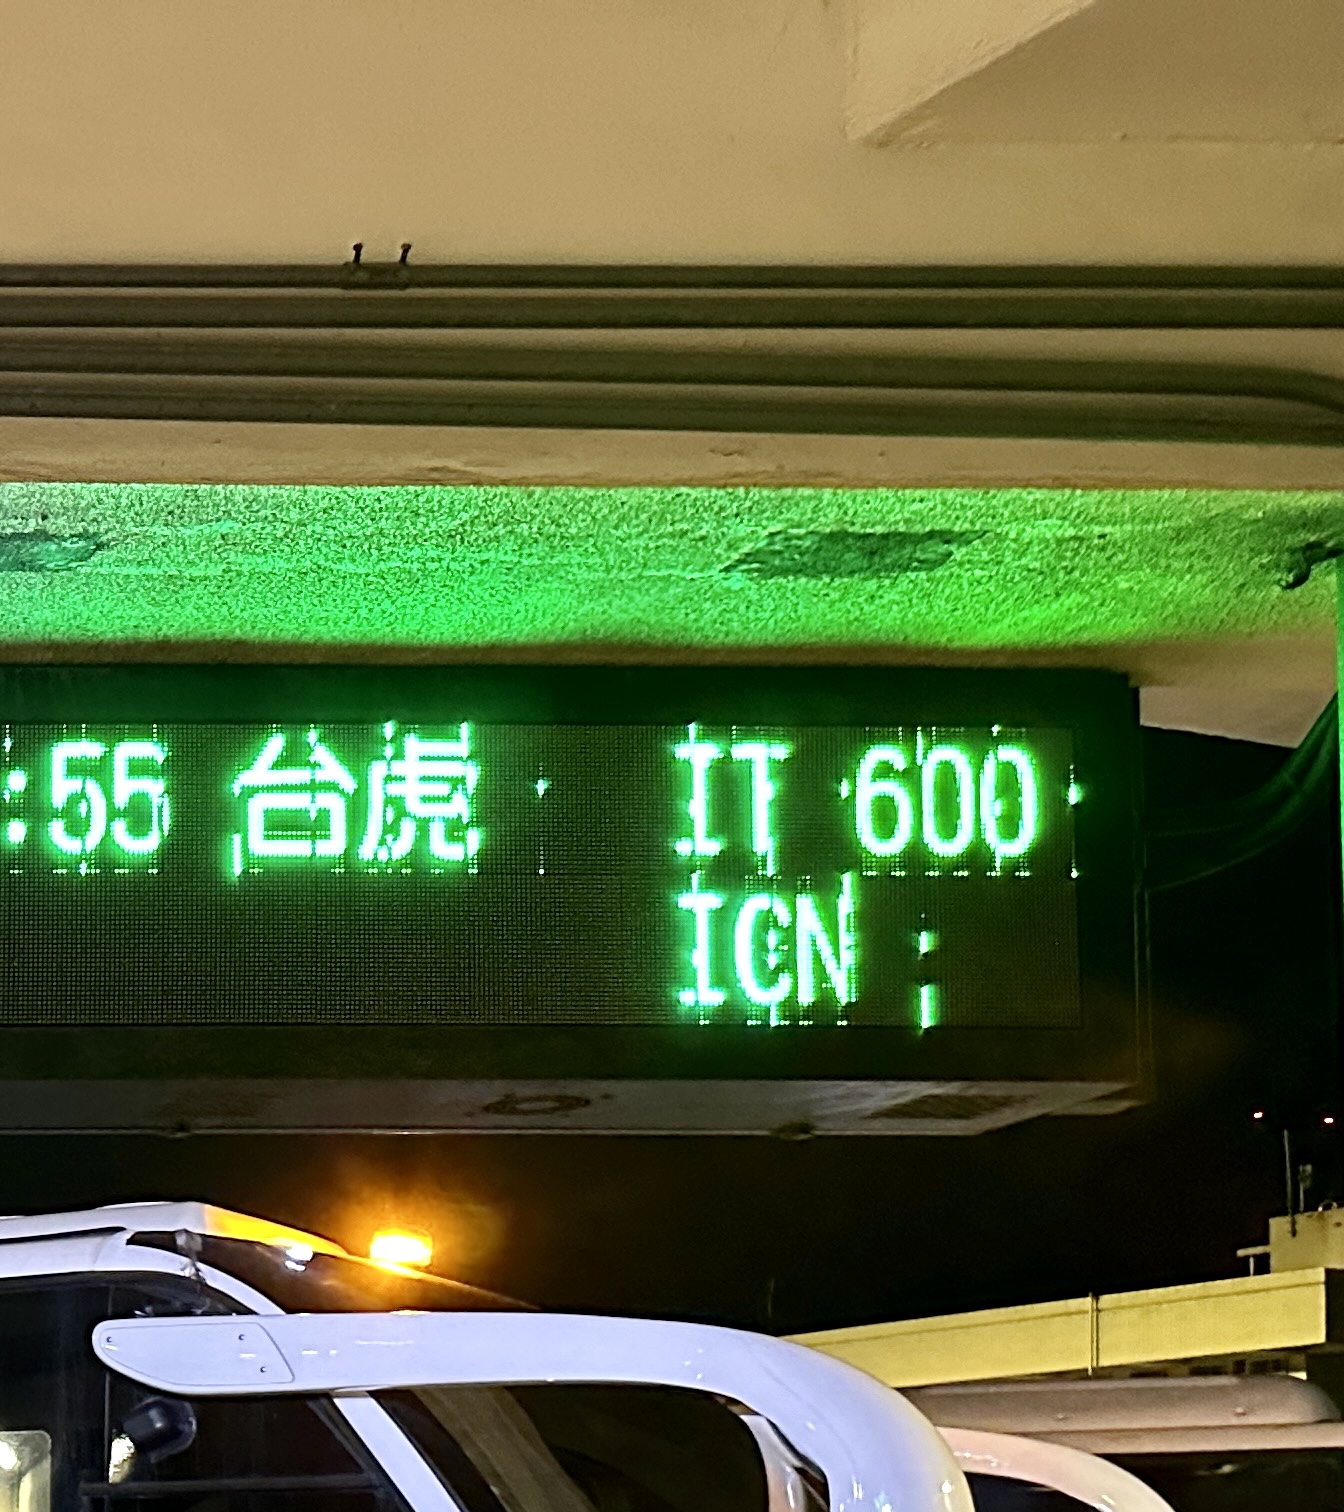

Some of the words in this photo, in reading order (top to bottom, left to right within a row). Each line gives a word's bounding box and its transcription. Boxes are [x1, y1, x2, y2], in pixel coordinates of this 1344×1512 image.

[230, 728, 482, 864] 台虎
[672, 738, 794, 858] IT
[855, 742, 1038, 858] 600
[676, 890, 860, 1008] ICN
